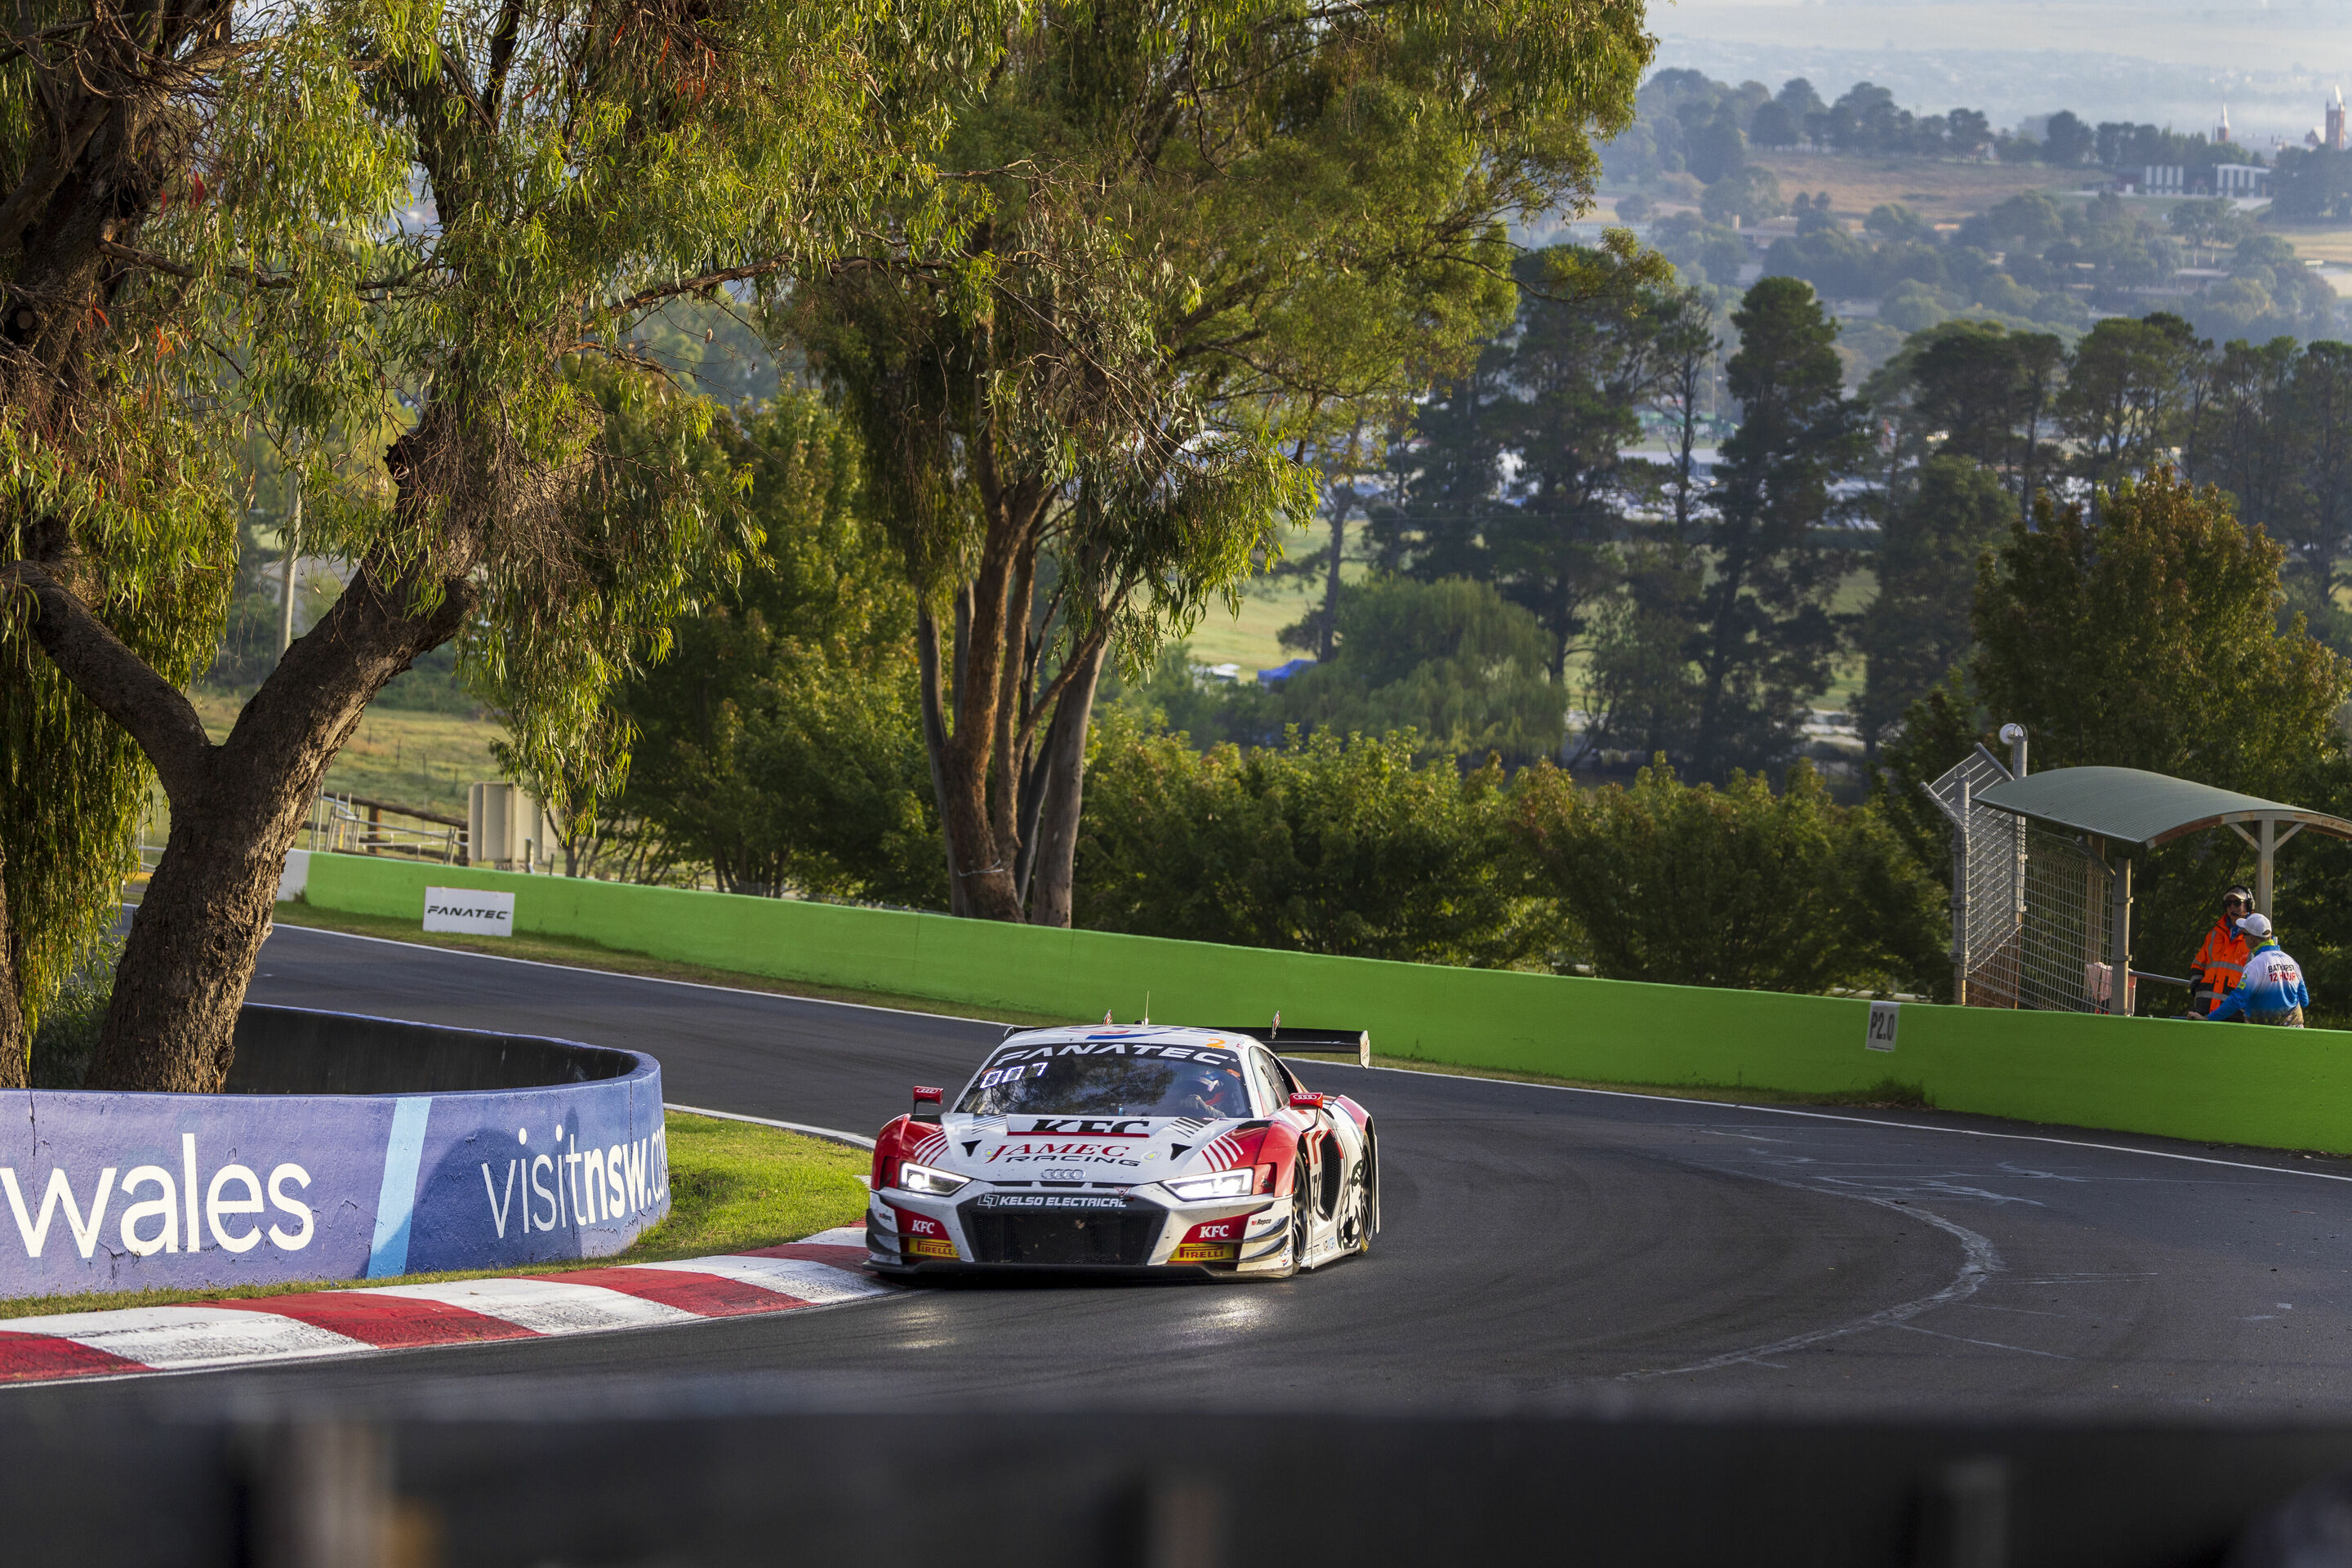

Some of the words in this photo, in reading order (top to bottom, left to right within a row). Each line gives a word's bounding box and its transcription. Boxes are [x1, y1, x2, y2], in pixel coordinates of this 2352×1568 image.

[427, 906, 508, 920] FANATEC
[2270, 973, 2278, 982] 12
[1869, 1011, 1895, 1041] P2.0
[1206, 1038, 1226, 1049] 2
[993, 1043, 1229, 1067] FANATEC
[1031, 1119, 1150, 1134] KFC
[985, 1143, 1130, 1164] JAMEC
[1005, 1156, 1141, 1167] RACING
[0, 1133, 314, 1258] wales
[1000, 1196, 1044, 1206] KELSO
[1045, 1196, 1127, 1208] ELECTRICAL
[911, 1219, 935, 1234] KFC
[1199, 1225, 1229, 1239] KFC
[917, 1241, 953, 1255] PIRELLI
[1179, 1245, 1224, 1258] PIRELLI
